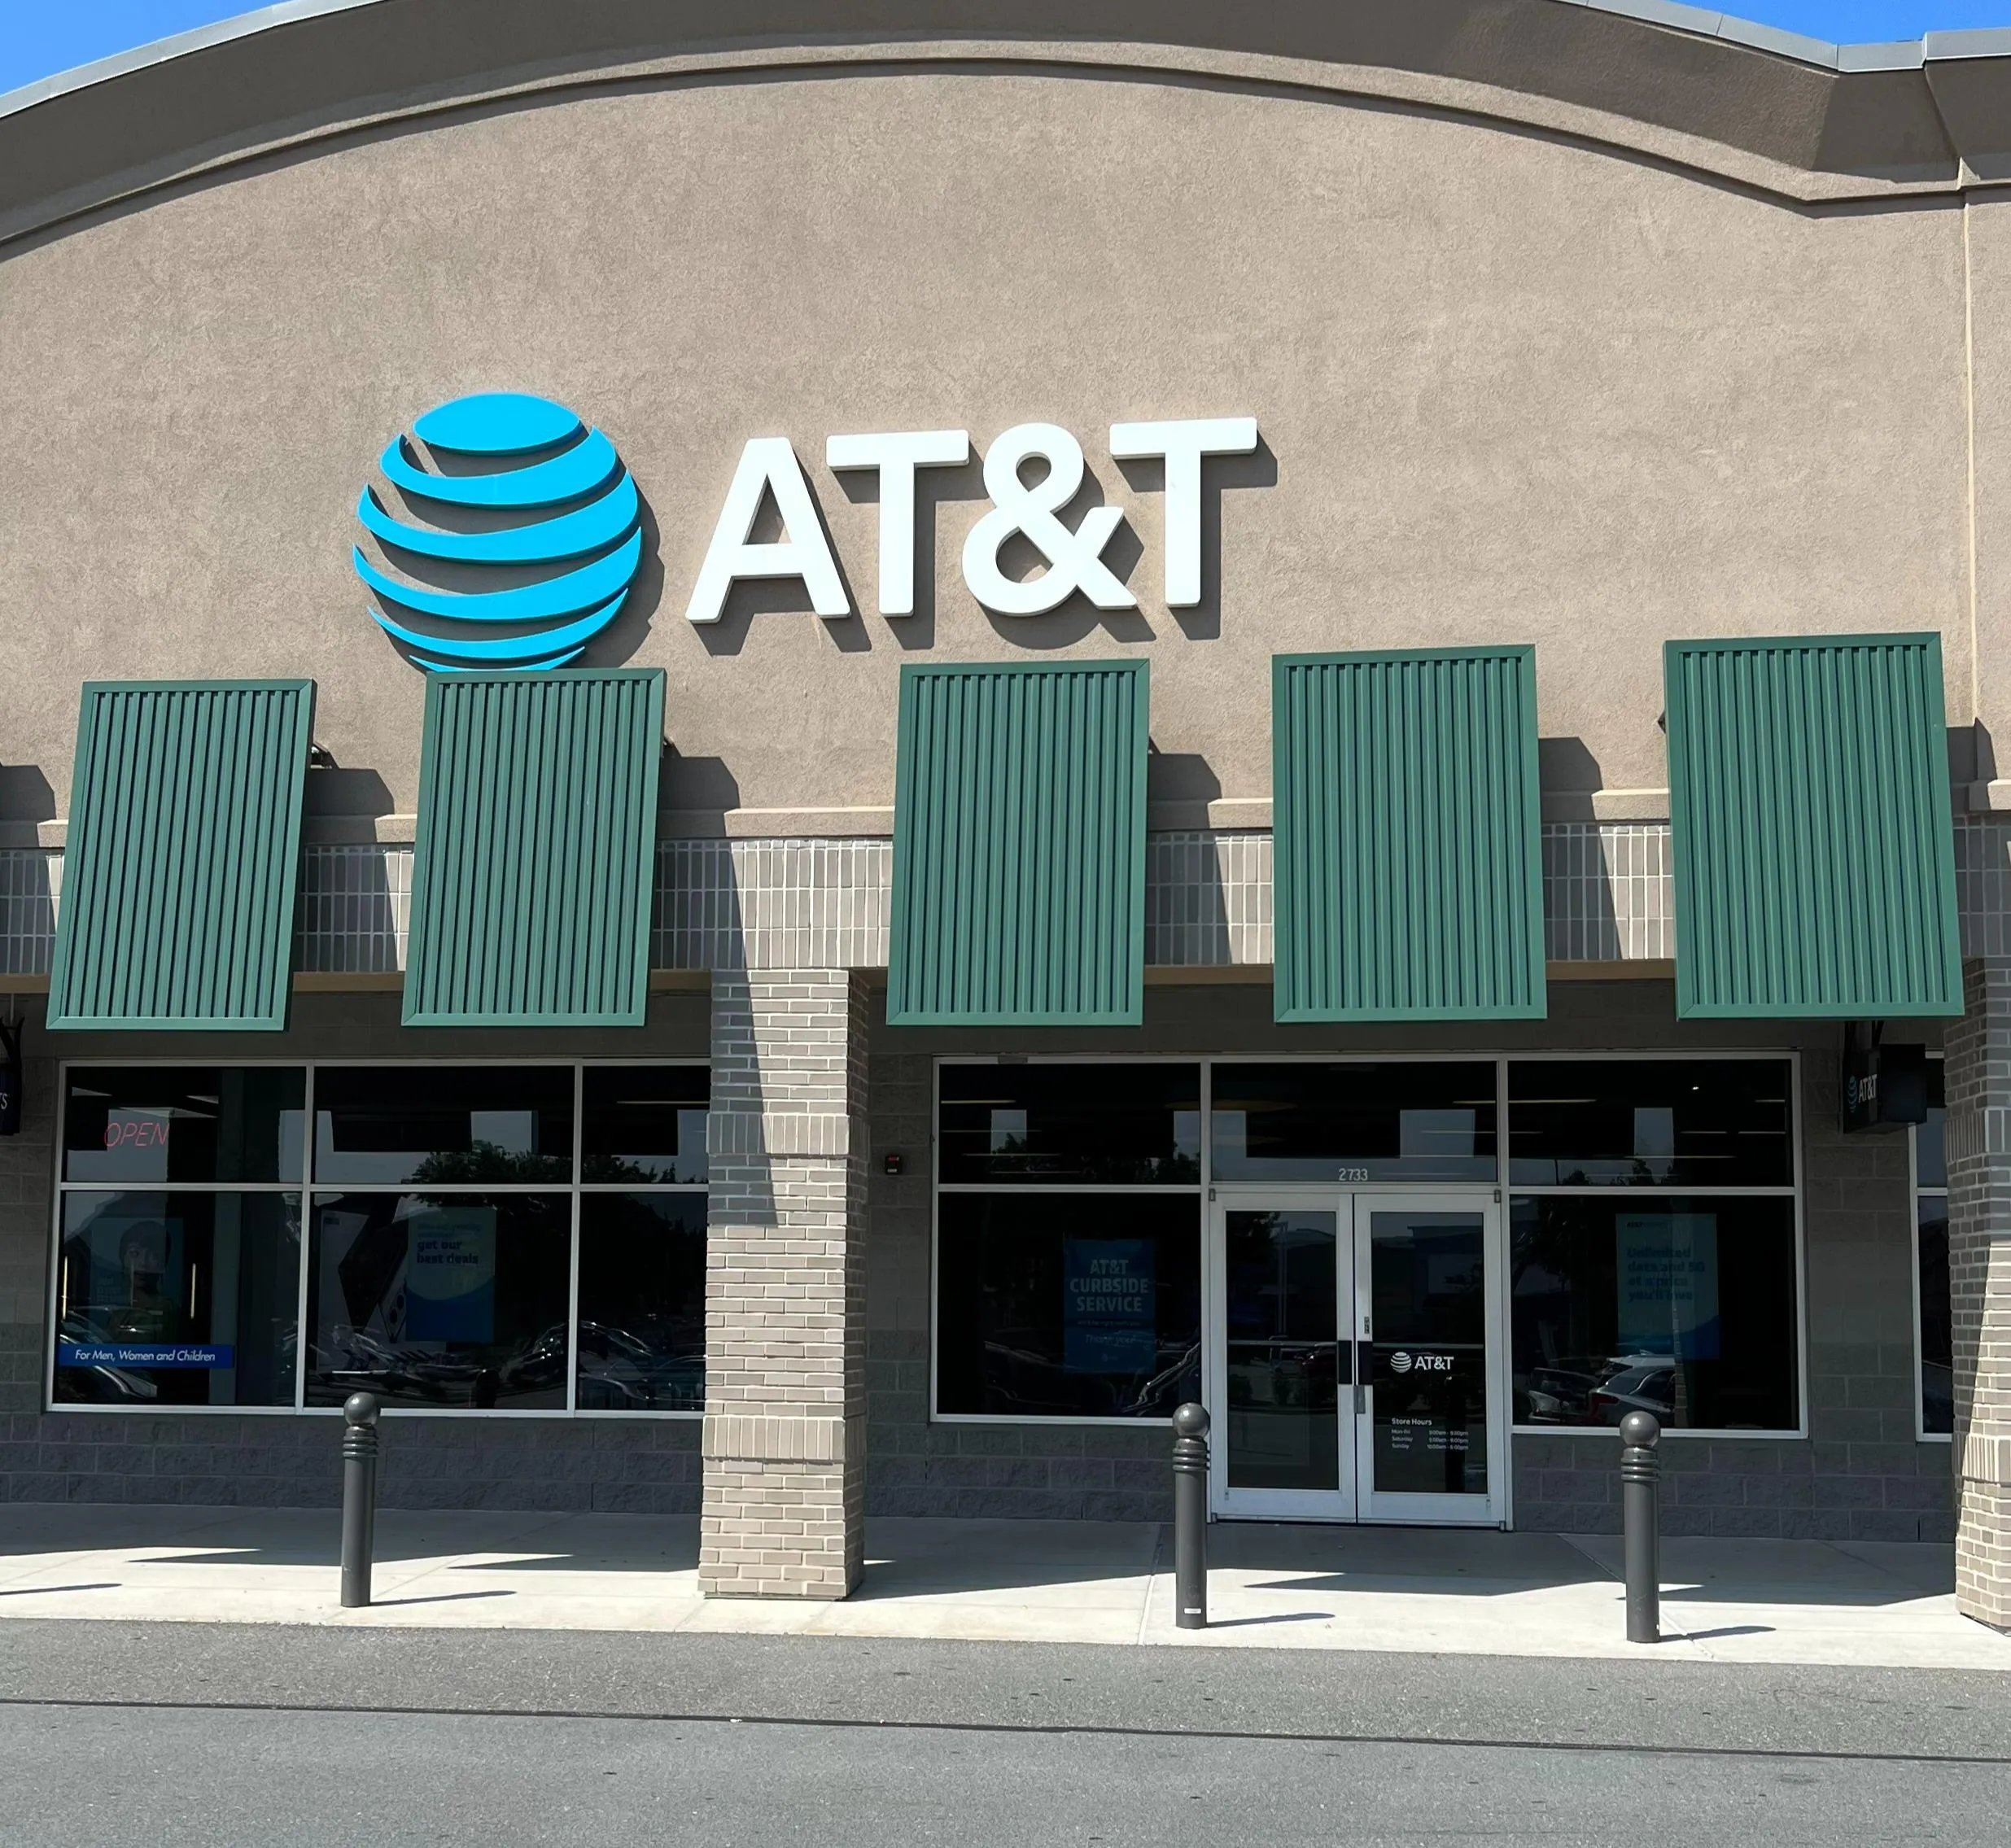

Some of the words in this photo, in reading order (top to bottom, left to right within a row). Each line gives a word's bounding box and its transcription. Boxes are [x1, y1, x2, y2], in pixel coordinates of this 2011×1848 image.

[685, 417, 1257, 623] AT&T
[1858, 1073, 1878, 1103] AT&T
[104, 1122, 169, 1147] OPEN
[1338, 1168, 1368, 1181] 2733
[417, 1240, 438, 1252] get
[441, 1241, 463, 1250] our
[417, 1253, 444, 1264] best
[446, 1253, 479, 1264] deals
[1089, 1260, 1130, 1274] AT&T
[1069, 1278, 1149, 1294] CURBSIDE
[1076, 1296, 1143, 1312] SERVICE
[75, 1349, 91, 1360] For
[92, 1350, 116, 1362] Men,
[119, 1350, 154, 1361] Women
[156, 1350, 176, 1361] and
[177, 1350, 216, 1361] Children
[1414, 1356, 1454, 1370] AT&T
[1391, 1418, 1410, 1426] Store
